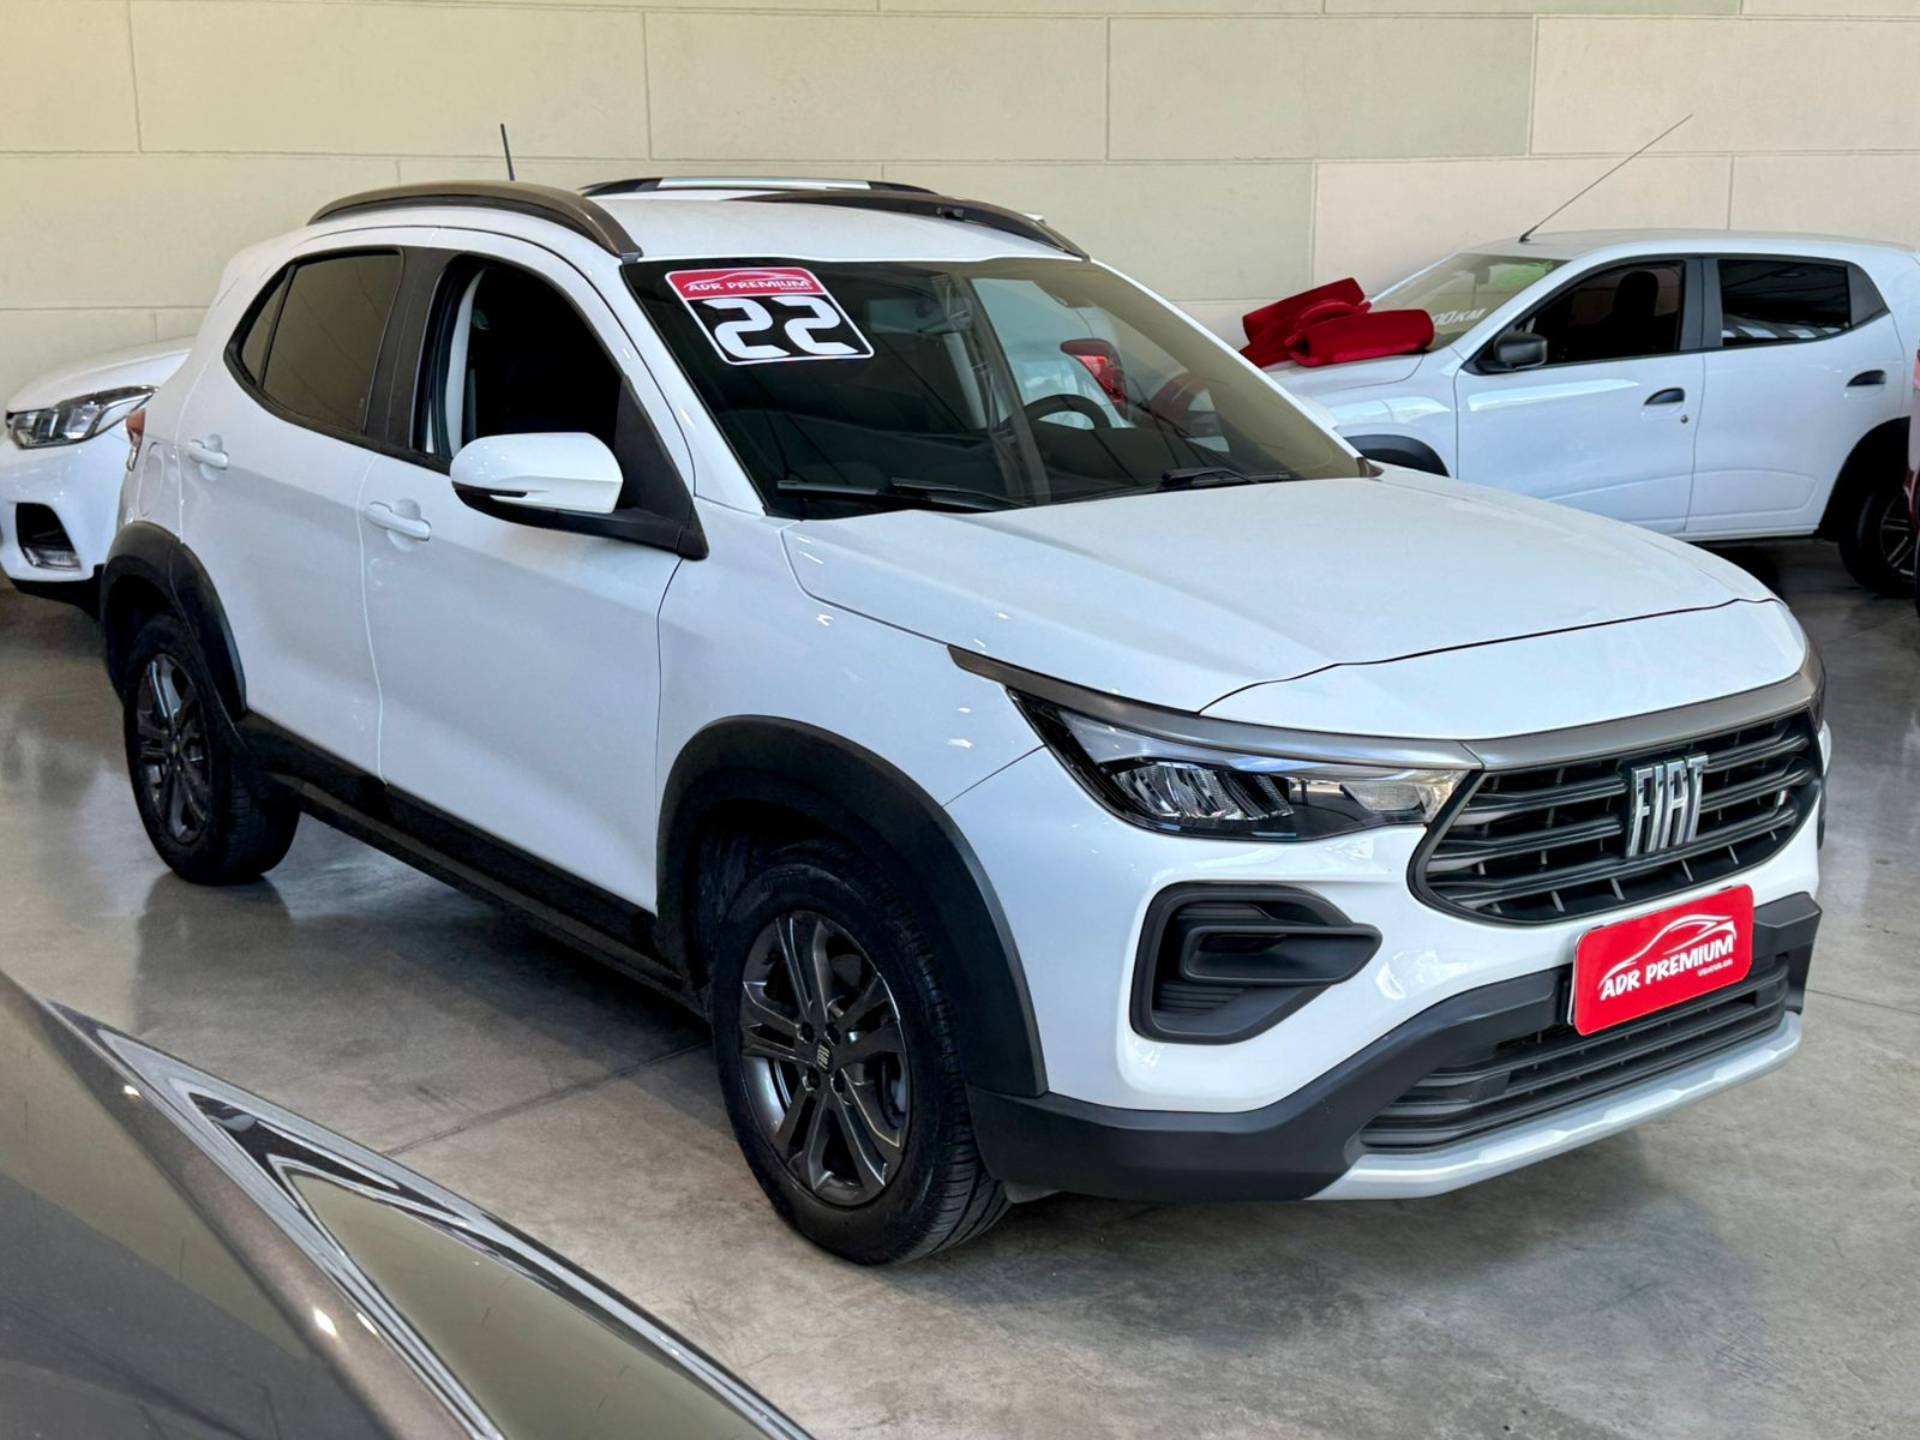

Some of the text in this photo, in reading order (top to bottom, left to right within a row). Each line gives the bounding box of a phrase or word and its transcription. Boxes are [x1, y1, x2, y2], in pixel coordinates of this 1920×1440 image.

[688, 280, 812, 292] ADR PREMIUM
[702, 295, 858, 359] 22
[1626, 754, 1709, 858] FIAT
[1600, 969, 1641, 1001] ADR
[1645, 934, 1734, 985] PREMIUM
